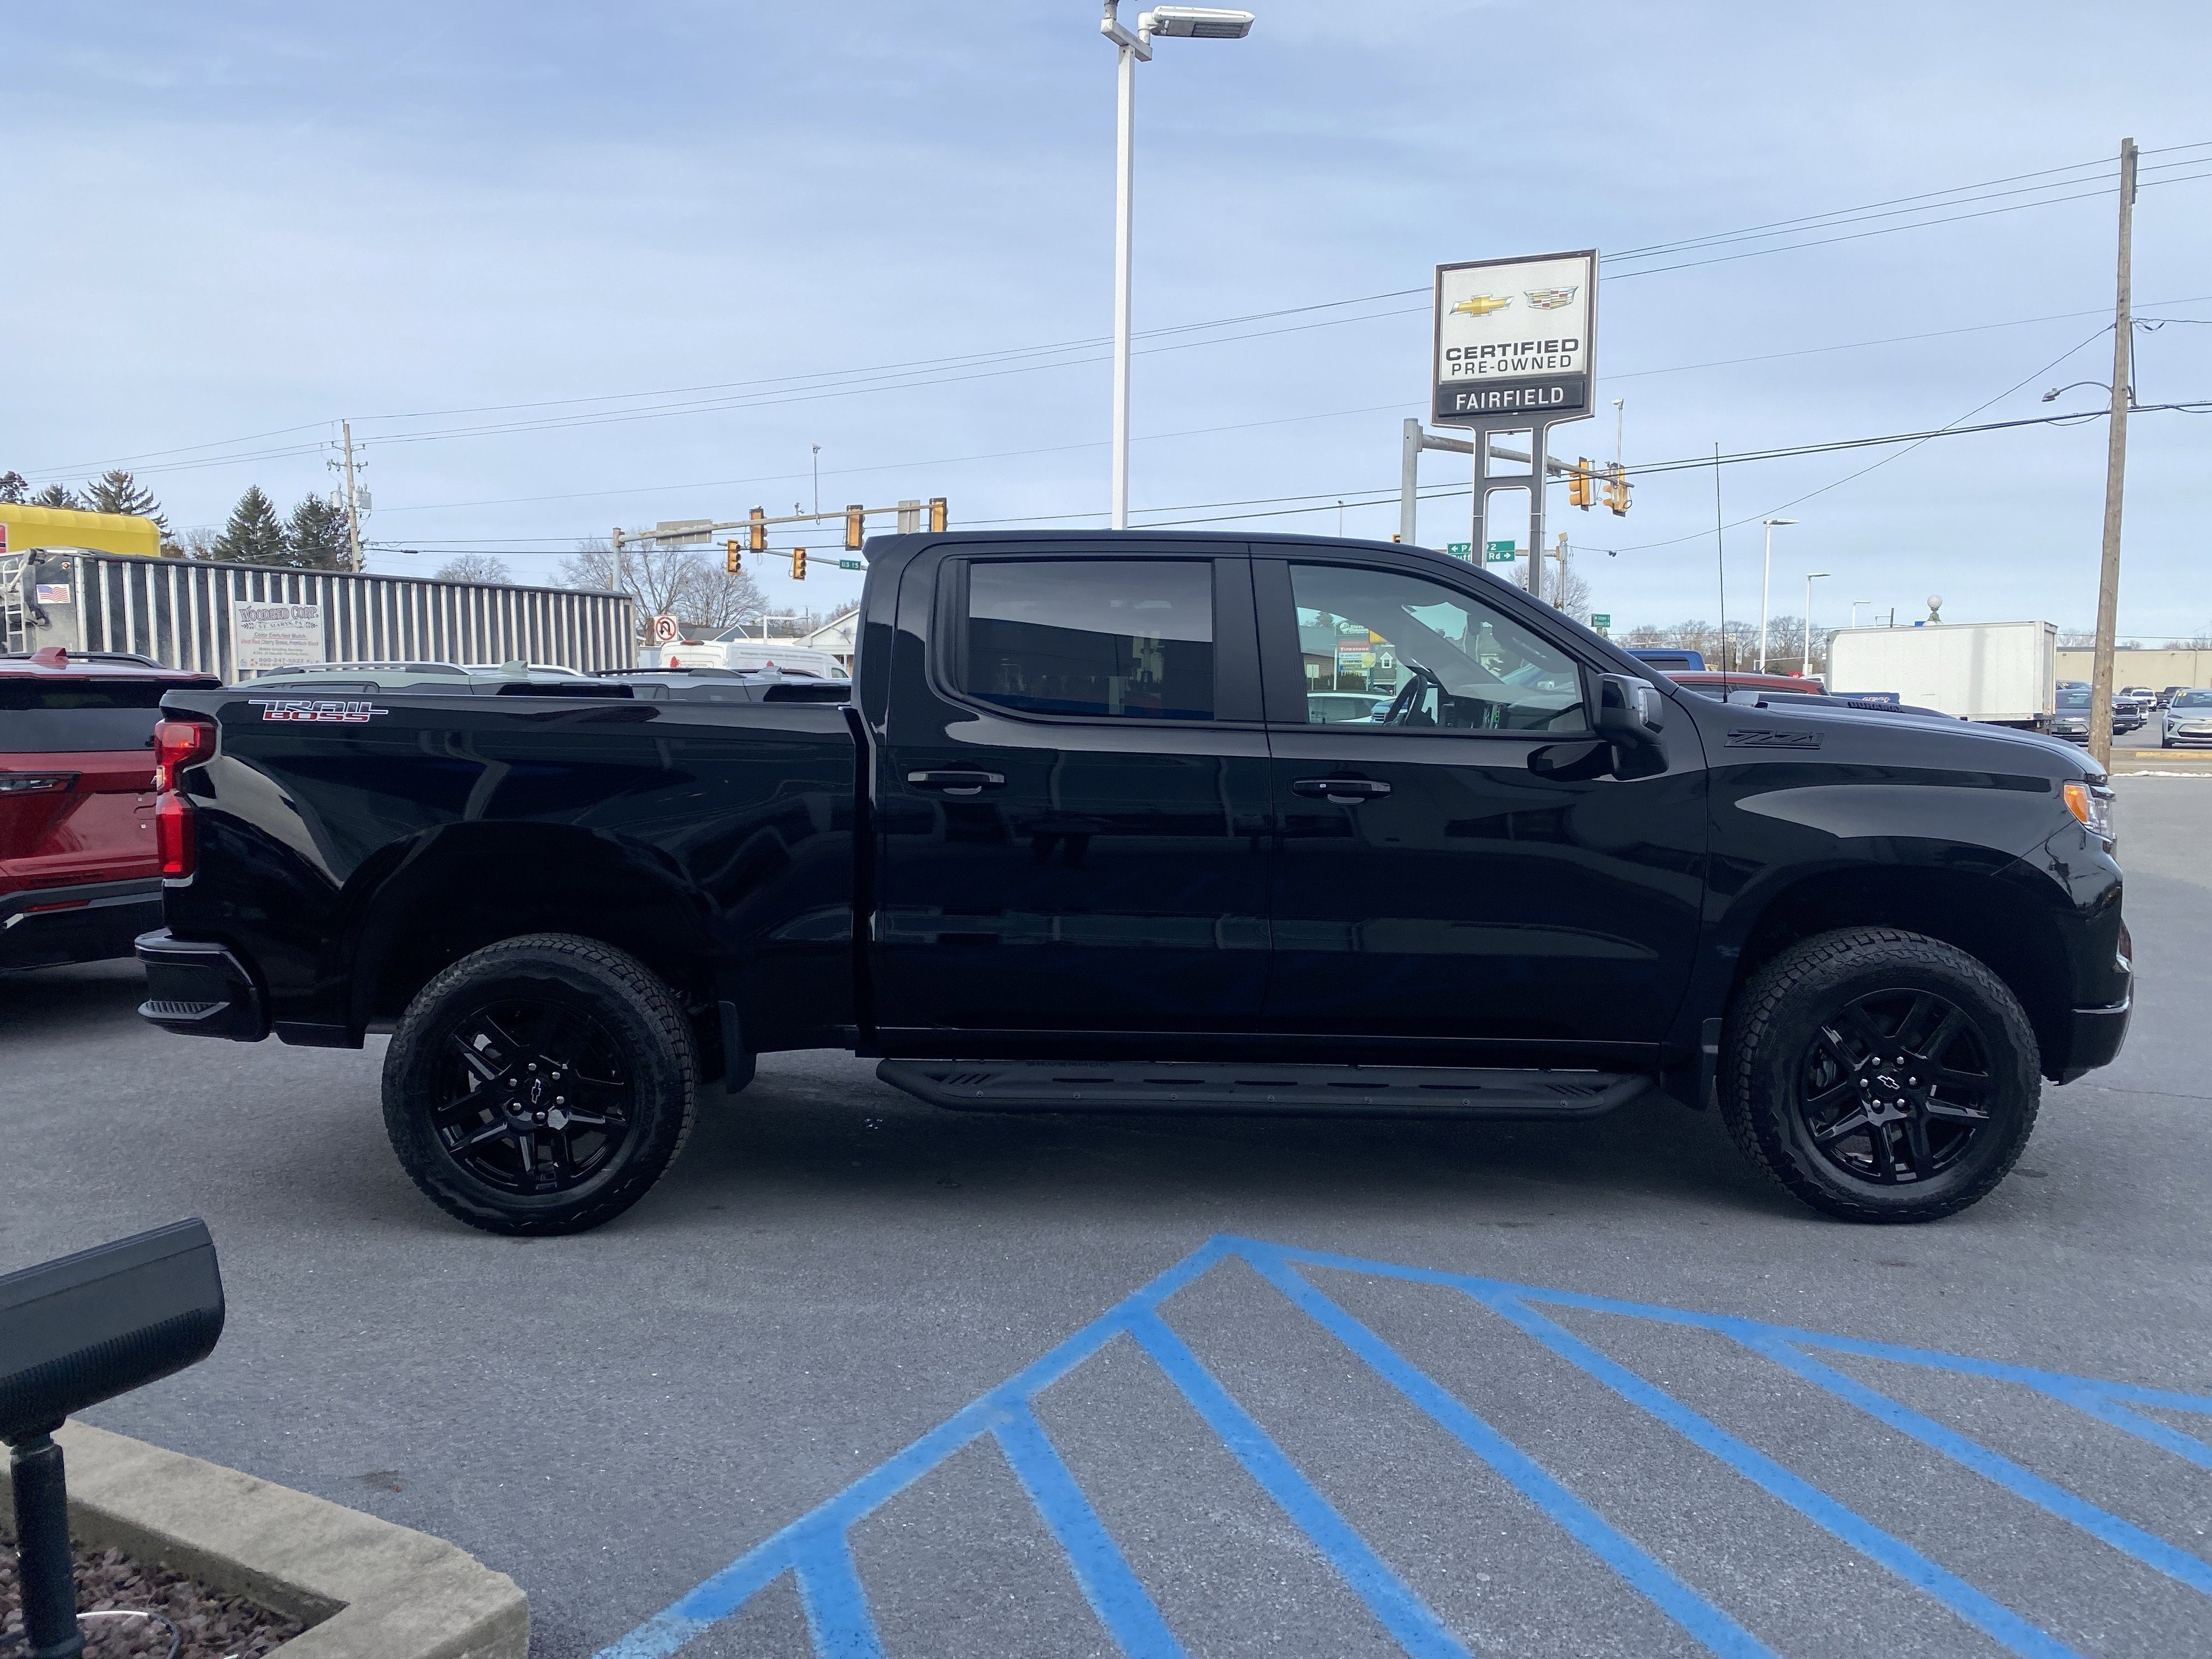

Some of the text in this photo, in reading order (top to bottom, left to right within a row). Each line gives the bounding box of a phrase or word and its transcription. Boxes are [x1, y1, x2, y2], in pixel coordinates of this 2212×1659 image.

[1446, 338, 1578, 361] CERTIFIED
[1452, 355, 1571, 375] PRE-OWNED
[1456, 387, 1564, 410] FAIRFIELD
[239, 606, 319, 622] WOODBED CORP.
[248, 699, 388, 715] TRAIL
[262, 710, 370, 723] BOSS
[1724, 728, 1825, 749] Z71
